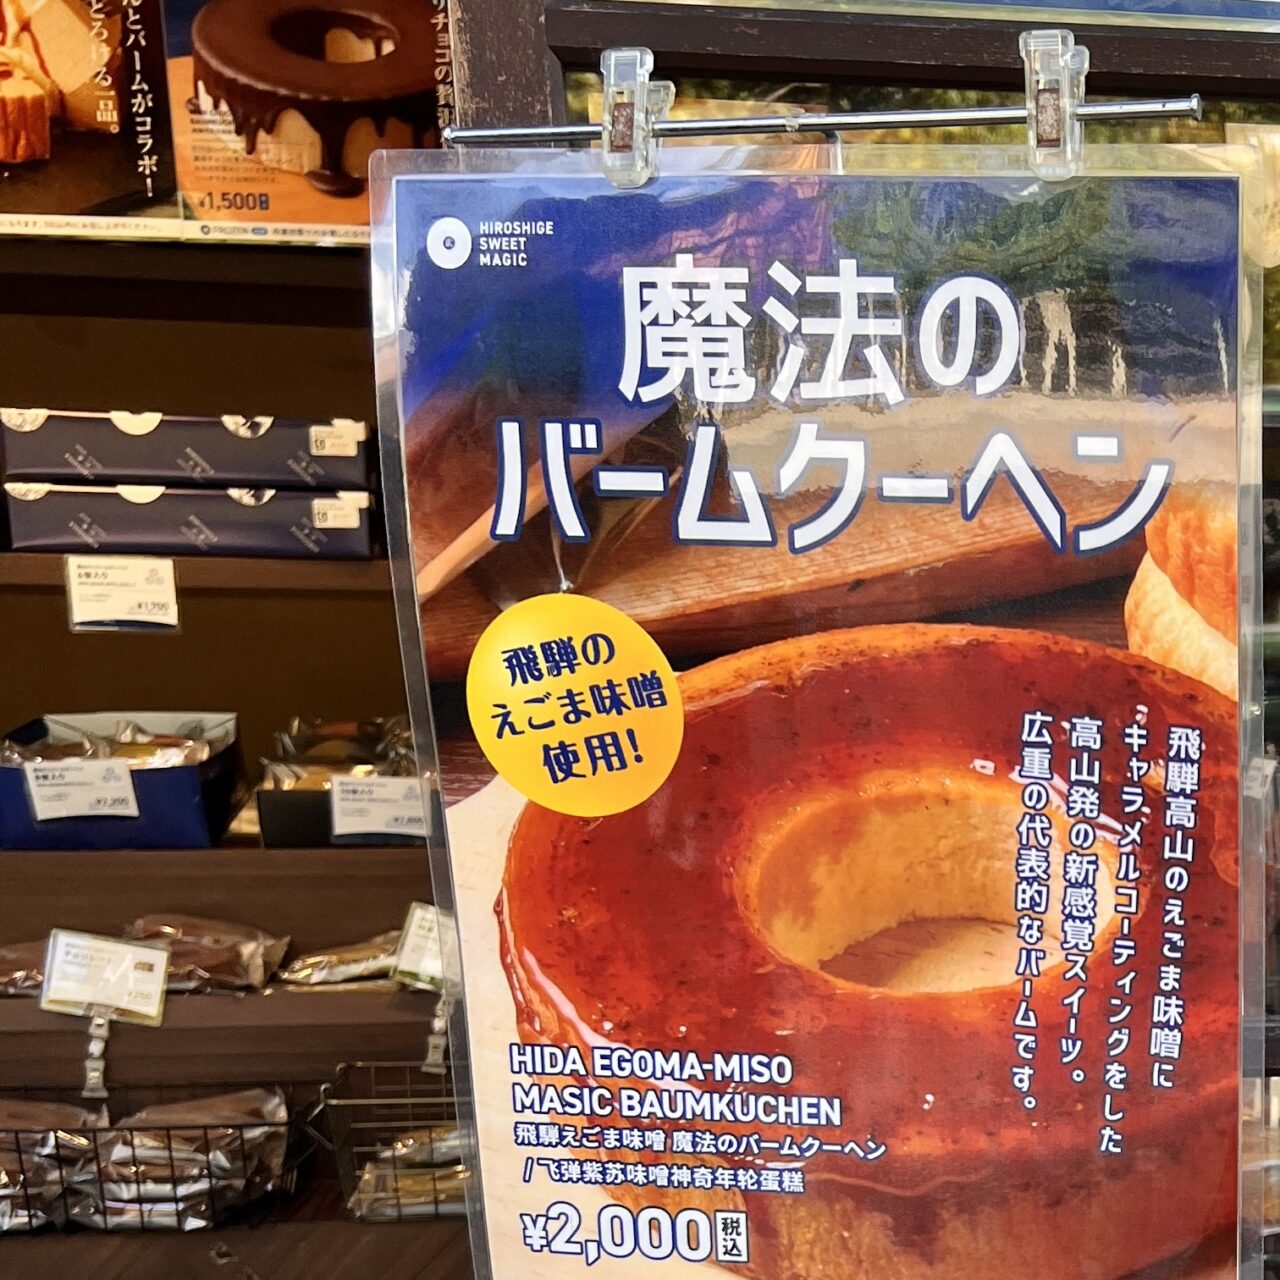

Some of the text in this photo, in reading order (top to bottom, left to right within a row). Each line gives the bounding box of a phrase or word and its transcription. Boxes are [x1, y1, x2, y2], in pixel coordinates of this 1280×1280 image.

[479, 221, 554, 235] HIROSHIGE
[479, 237, 527, 251] SWEET
[479, 252, 528, 267] MAGIC
[616, 252, 1022, 407] 魔法の
[491, 418, 1172, 552] バームクーヘン
[501, 632, 616, 688] 飛騨の
[490, 670, 668, 740] えごま味噌
[541, 727, 646, 785] 使用!
[1011, 710, 1054, 1110] 広重の代表的なバームです。
[1060, 716, 1104, 1083] 高山発の新感覚スイーツ。
[1149, 725, 1202, 1089] 飛騨高山のえごま味噌に
[1099, 722, 1150, 1154] キャラメルコーティングをした
[510, 1043, 793, 1086] HIDA EGOMA-MISO
[513, 1083, 842, 1126] MASIC BAUMKUCHEN
[520, 1200, 714, 1266] ¥2,000
